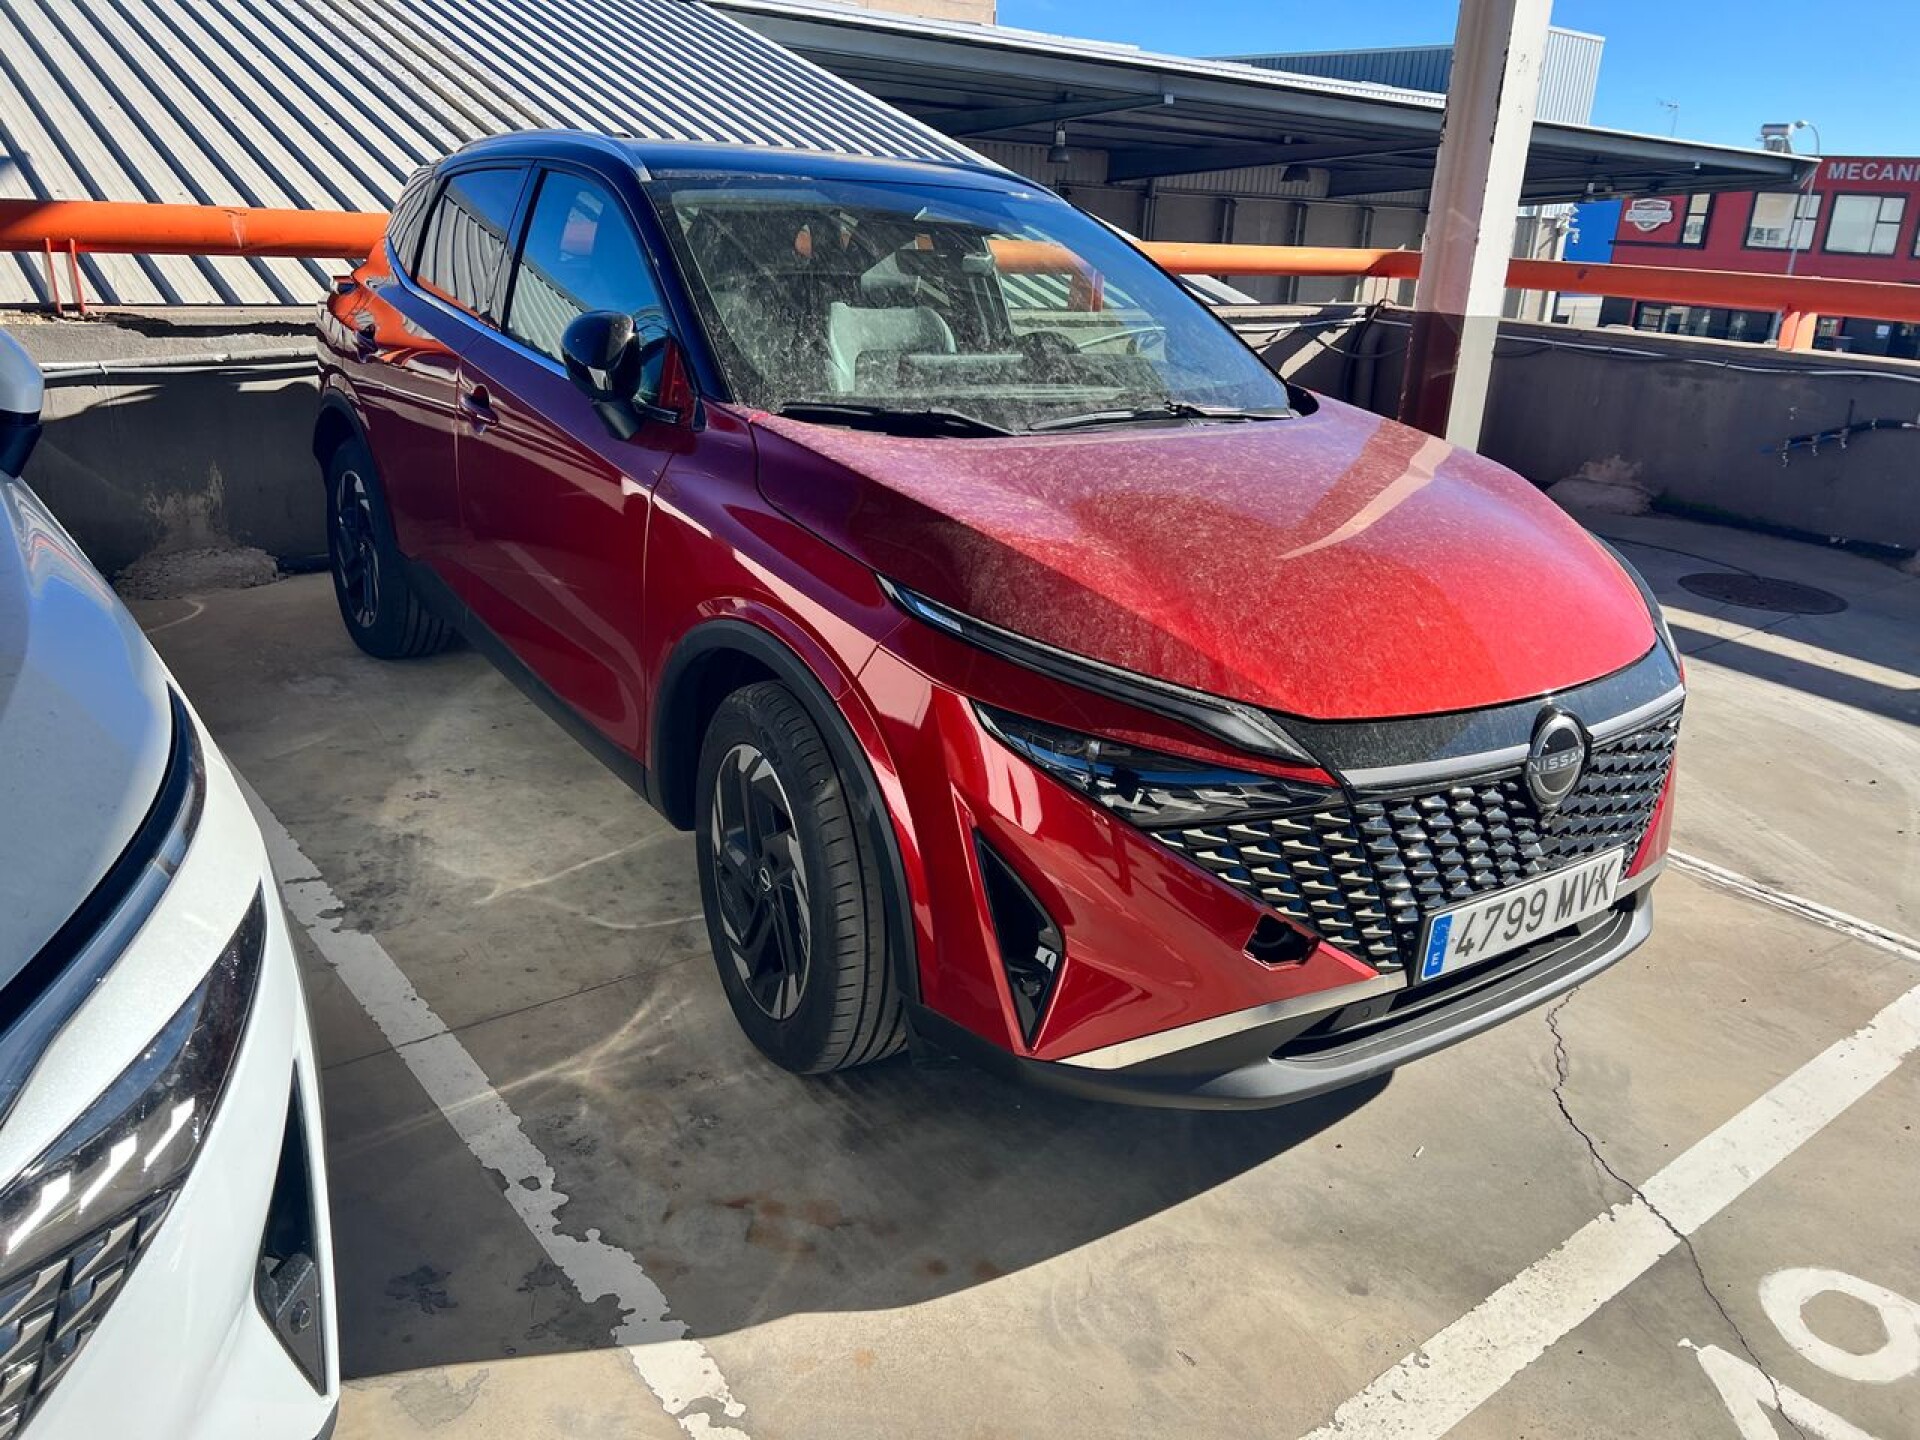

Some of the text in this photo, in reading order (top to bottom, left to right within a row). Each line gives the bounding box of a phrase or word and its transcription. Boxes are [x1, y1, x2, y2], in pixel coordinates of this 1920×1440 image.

[1455, 857, 1618, 957] 4799 MVK
[1430, 951, 1441, 967] E
